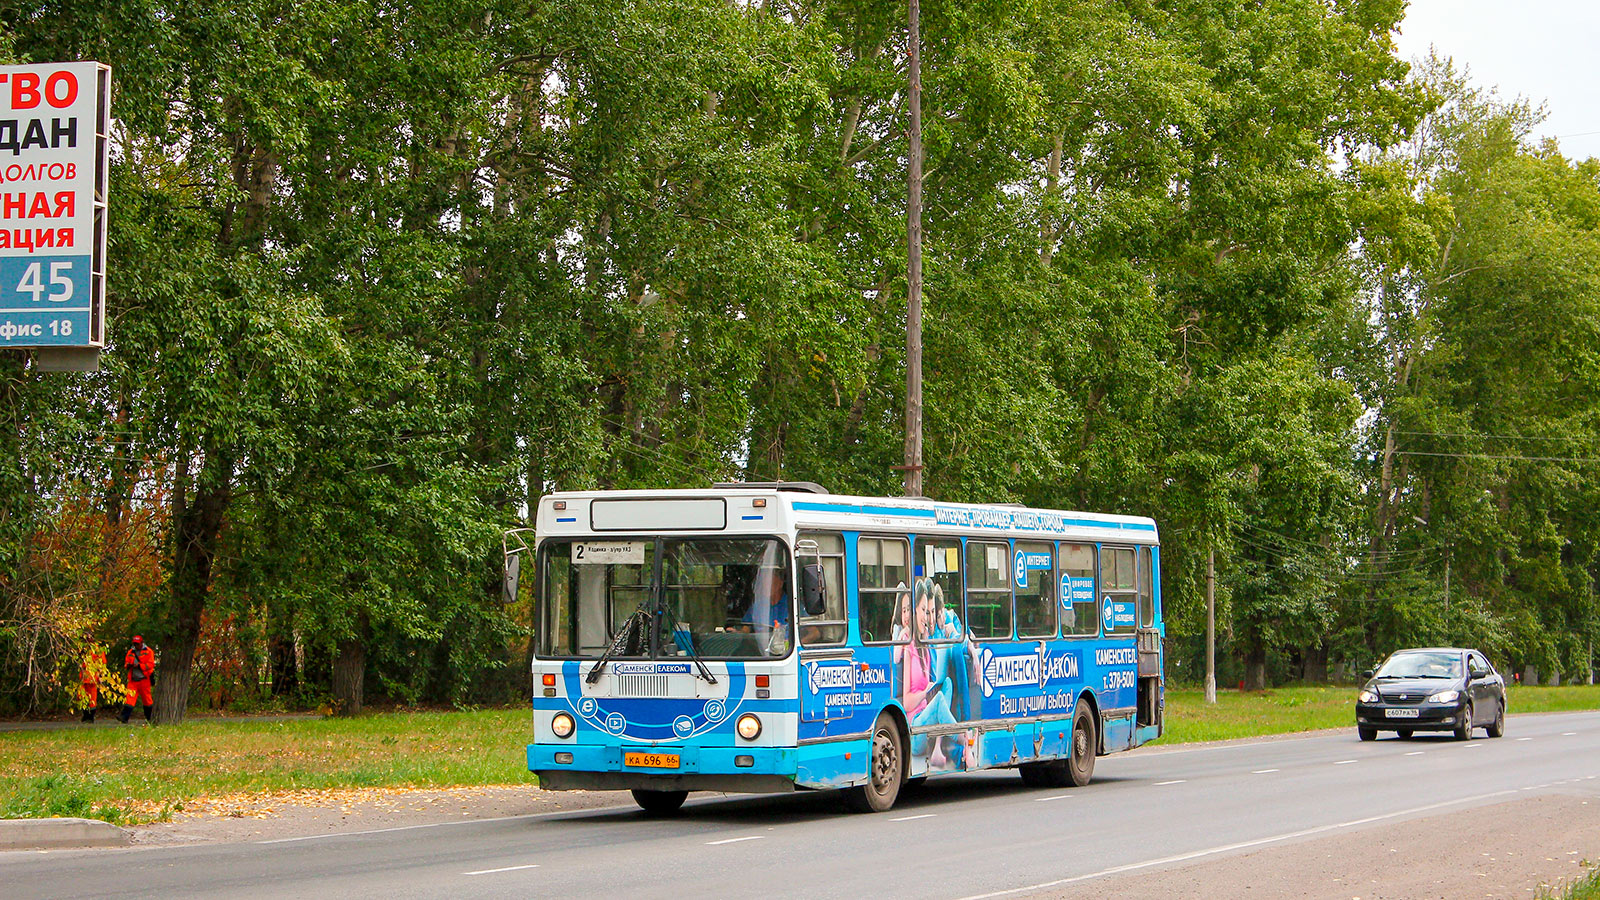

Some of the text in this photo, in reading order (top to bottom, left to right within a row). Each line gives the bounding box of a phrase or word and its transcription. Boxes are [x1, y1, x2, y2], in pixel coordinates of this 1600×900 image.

[0, 70, 78, 110] ВО
[0, 162, 77, 183] ОЛГОВ
[0, 191, 76, 220] НАЯ
[16, 262, 74, 302] 45
[49, 319, 72, 337] 18
[576, 545, 584, 559] 2
[1027, 555, 1050, 566] ИНТЕРНЕТ
[824, 692, 872, 707] KAMENSKTEL.RU
[1000, 688, 1074, 716] Ваш лучший выбор!
[644, 755, 661, 765] 696
